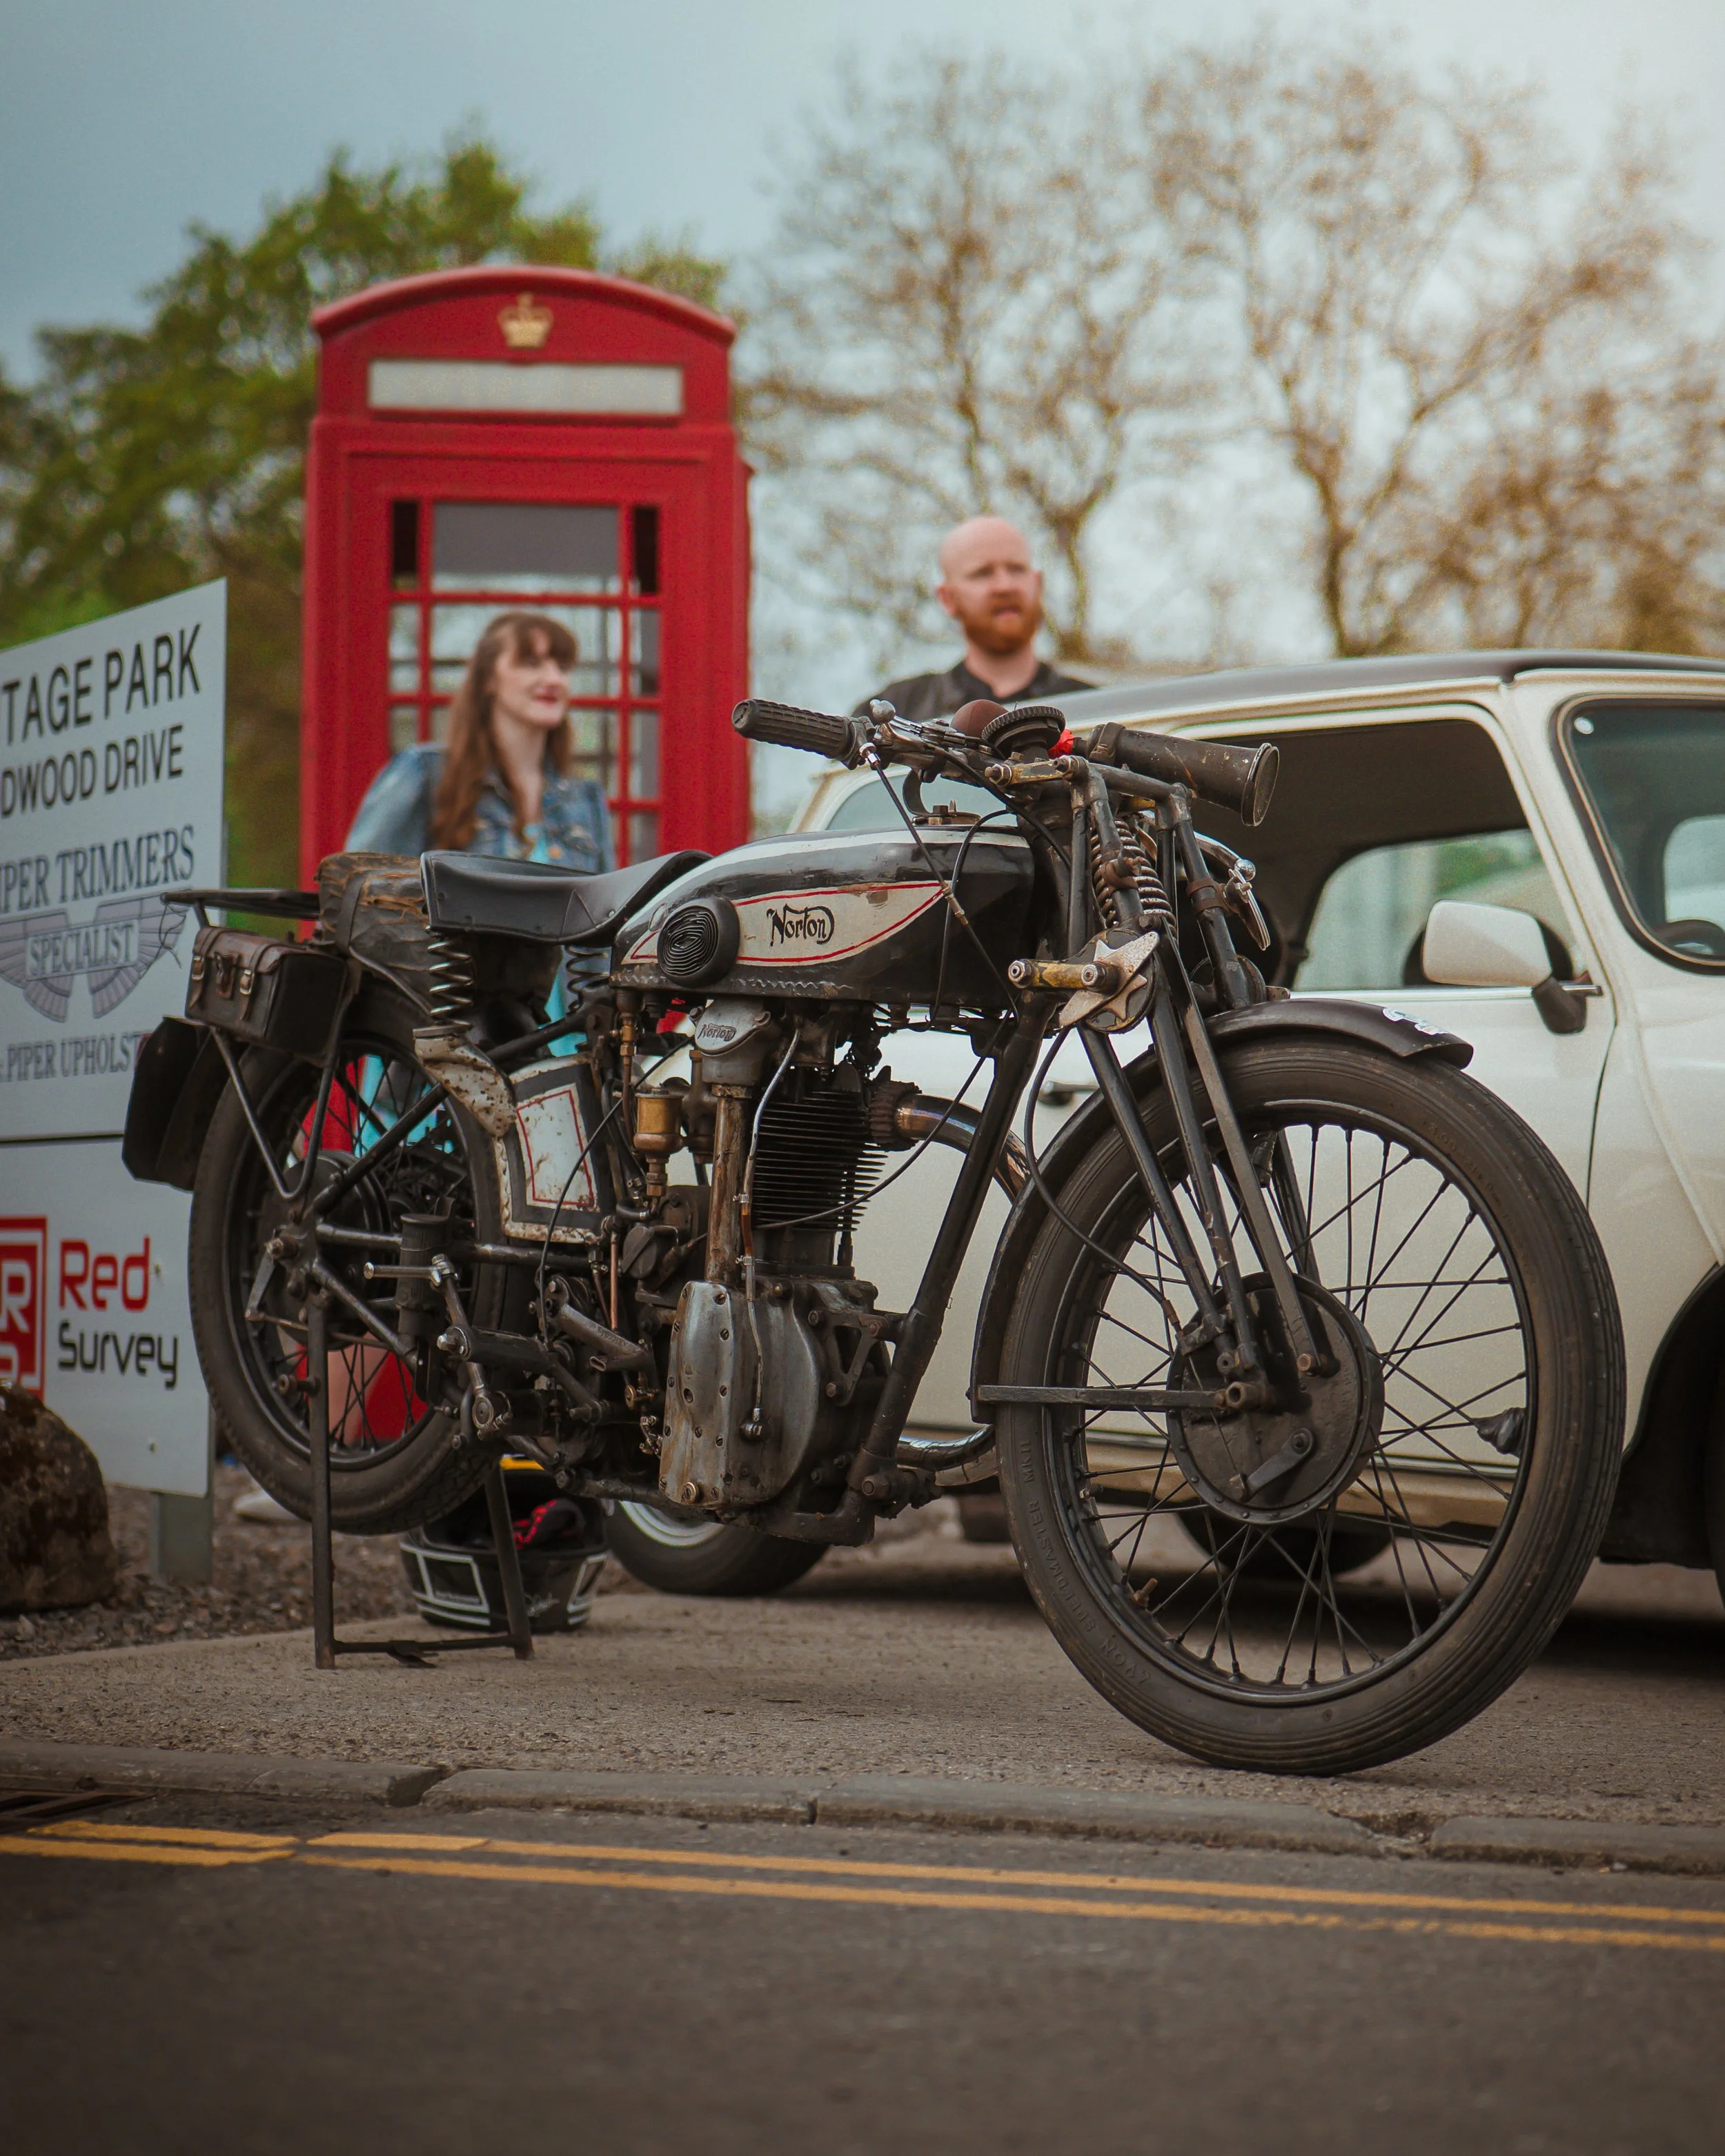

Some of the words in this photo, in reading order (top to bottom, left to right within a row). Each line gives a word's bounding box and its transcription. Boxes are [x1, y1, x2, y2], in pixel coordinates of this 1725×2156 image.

[3, 657, 92, 746] TAGE
[104, 622, 201, 720] PARK
[1, 749, 96, 818] DWOOD
[105, 724, 183, 794] DRIVE
[56, 824, 194, 904] TRIMMERS
[30, 923, 135, 976] SPECIALIST
[766, 903, 836, 947] Norton
[7, 1040, 56, 1082] PIPER
[697, 1022, 737, 1042] Norton
[59, 1236, 150, 1312] Red
[58, 1318, 179, 1390] Survey
[1027, 1499, 1097, 1633] SPEEDMASTER
